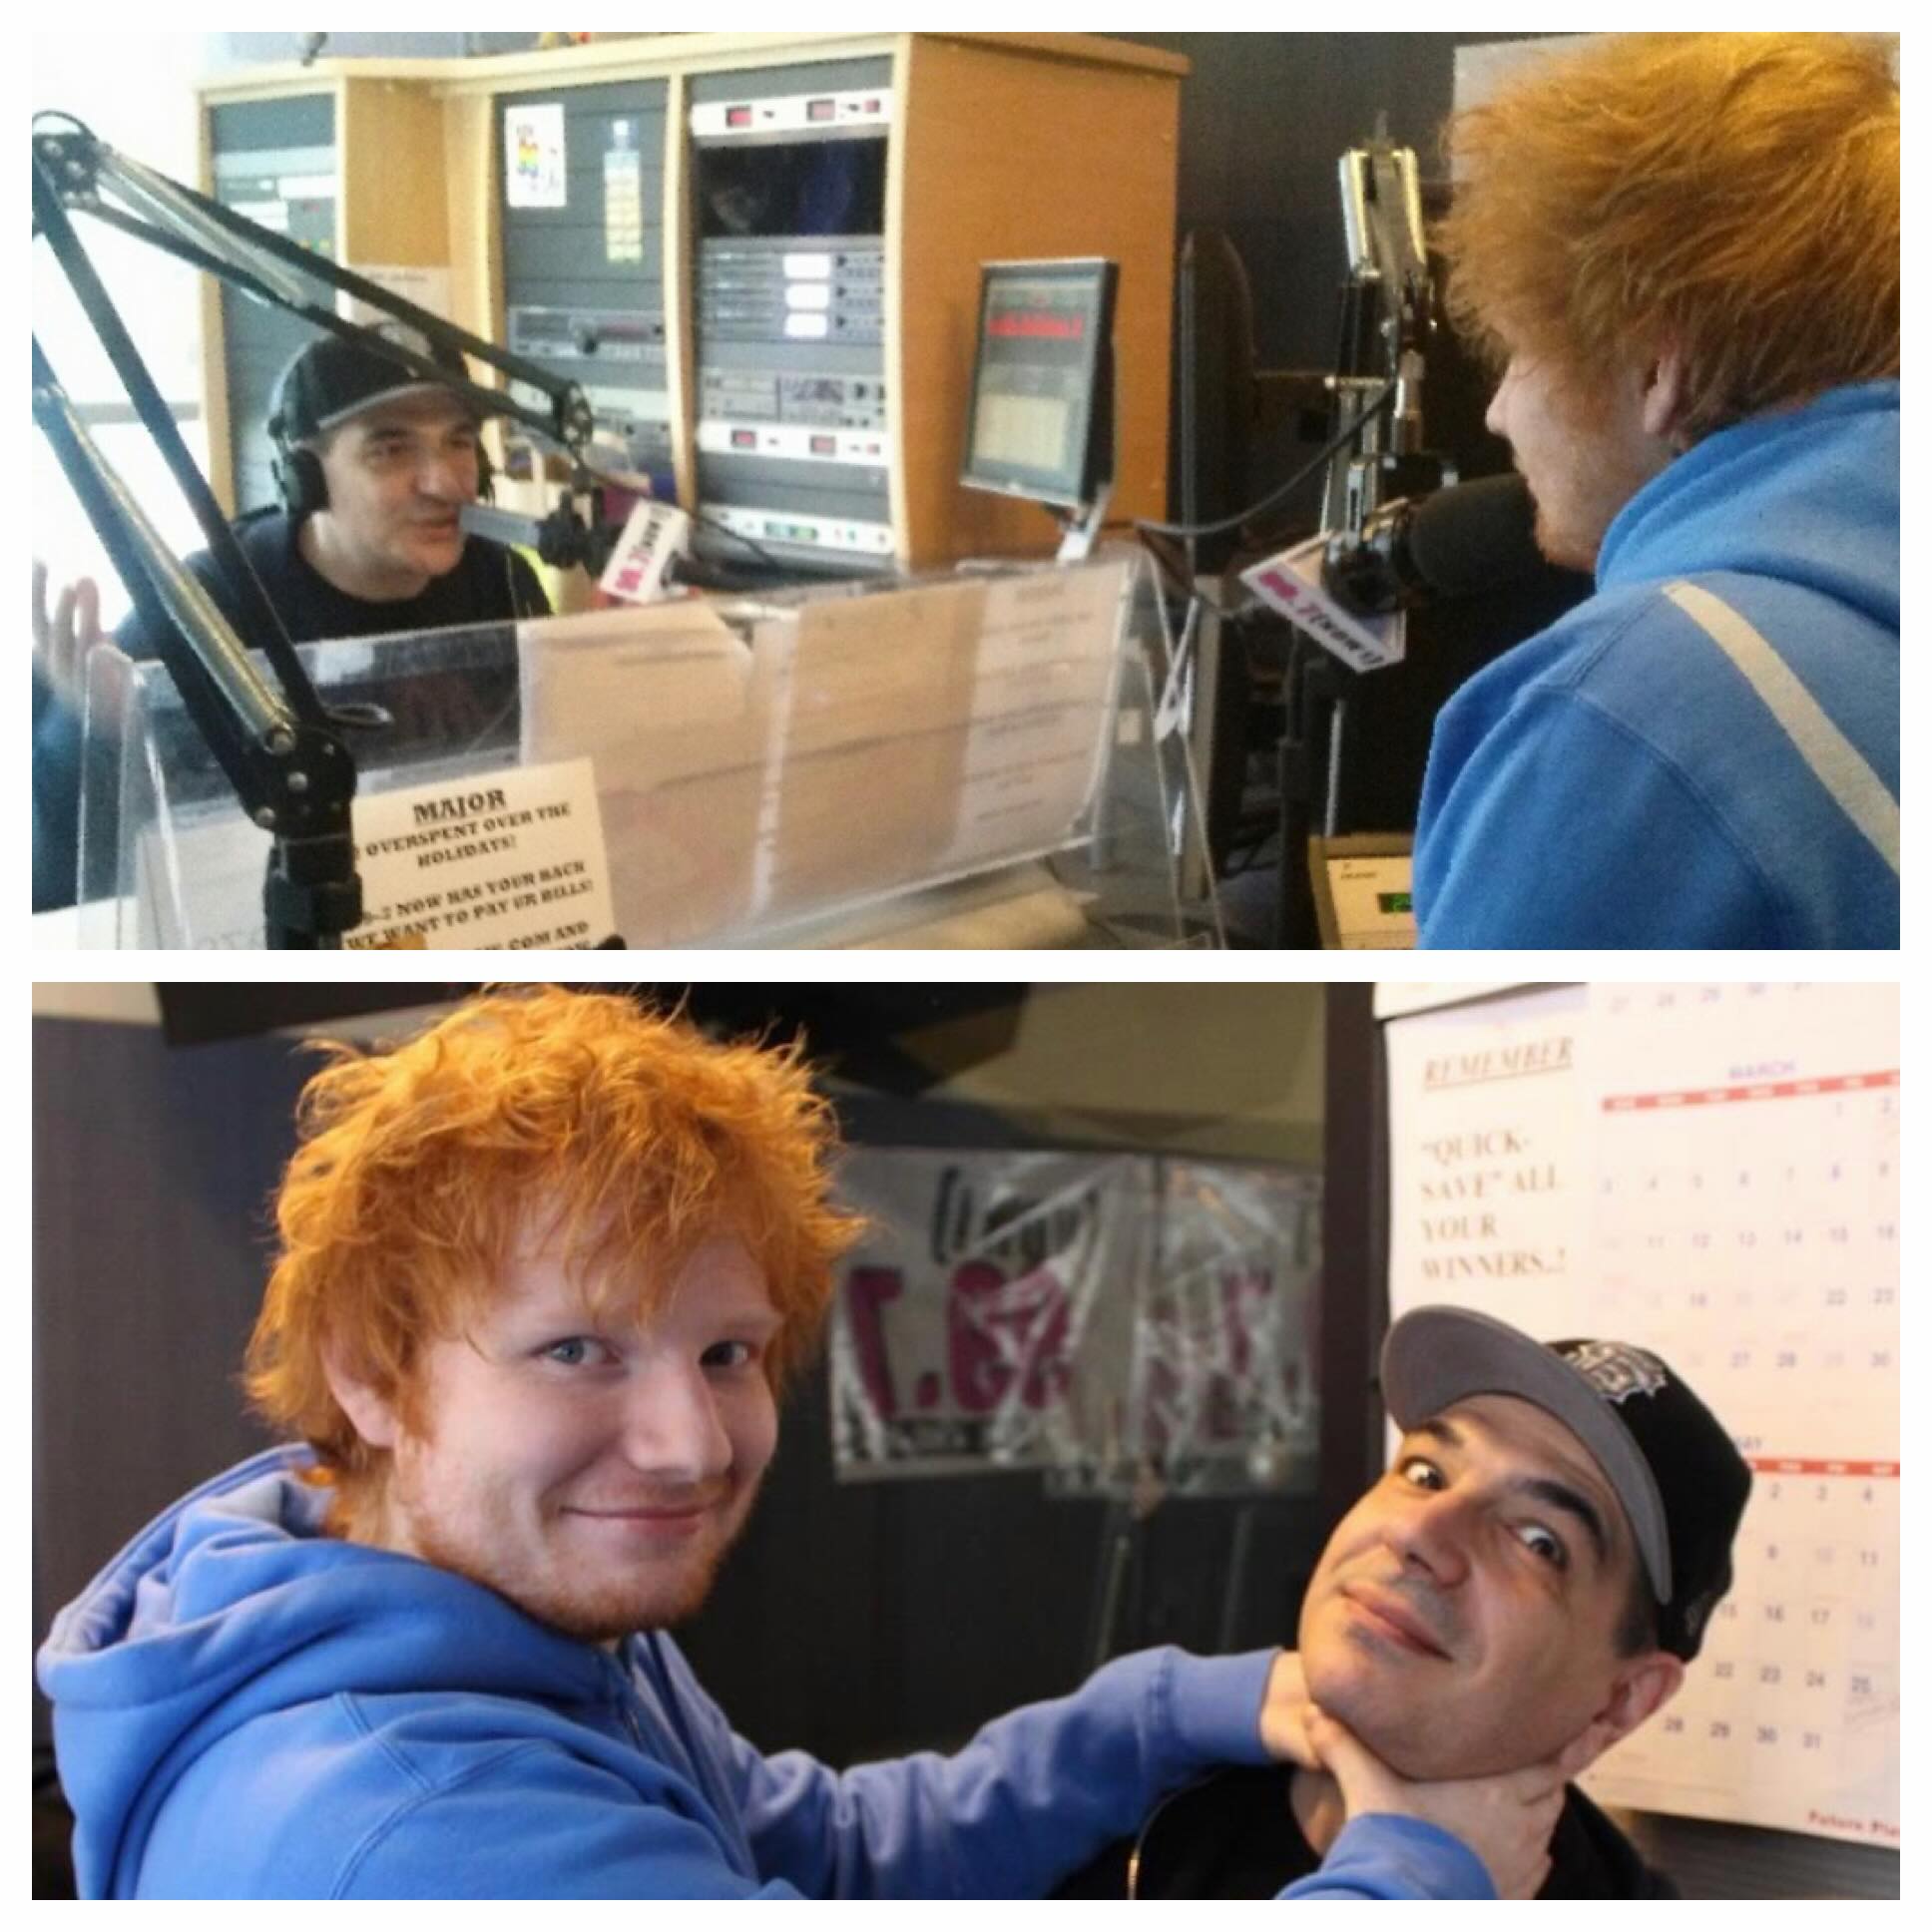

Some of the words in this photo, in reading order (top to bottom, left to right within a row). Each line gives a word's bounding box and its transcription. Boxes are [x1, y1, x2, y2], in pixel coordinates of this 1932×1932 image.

[413, 788, 508, 824] MAJOR
[365, 821, 479, 856] OVERSPENT
[483, 809, 533, 833] OVER
[536, 801, 572, 821] THE
[417, 834, 518, 868] HOLIDAYS!
[396, 893, 441, 916] NOW
[446, 882, 481, 906] HAS
[485, 871, 535, 894] YOUR
[539, 860, 586, 882] BACK
[383, 913, 440, 941] WANT
[443, 907, 470, 928] TO
[474, 900, 508, 919] PAY
[513, 892, 537, 911] UR
[541, 878, 593, 903] BILLS!
[555, 920, 590, 940] AND
[1424, 1037, 1575, 1086] REMEMBER
[1728, 1059, 1795, 1080] MARCH
[1513, 1163, 1560, 1195] ALL
[1421, 1213, 1500, 1242] YOUR
[1764, 1605, 1784, 1623] 16
[1810, 1608, 1831, 1626] 17
[1714, 1663, 1734, 1680] 22
[1760, 1667, 1781, 1685] 23
[1805, 1671, 1826, 1689] 24
[1664, 1716, 1684, 1734] 28
[1709, 1721, 1730, 1740] 29
[1756, 1726, 1777, 1744] 30
[1802, 1731, 1822, 1749] 31
